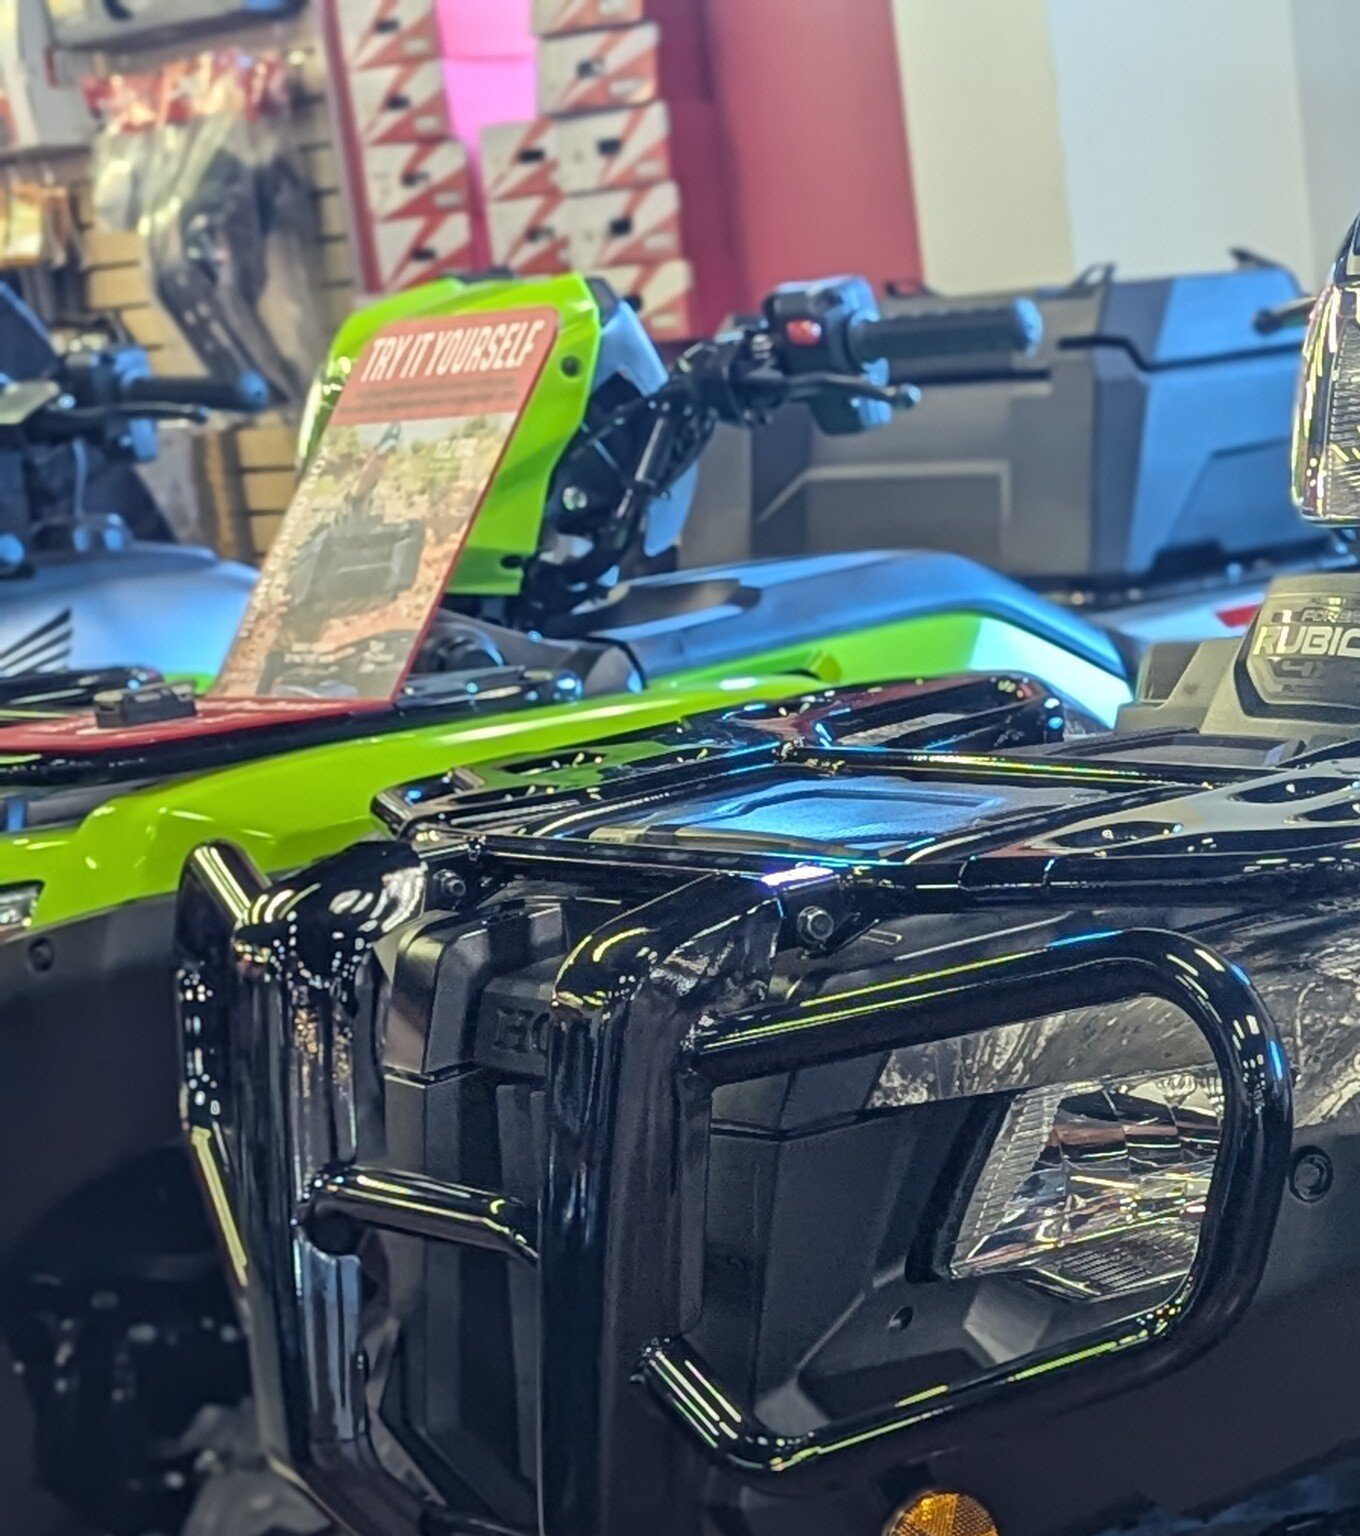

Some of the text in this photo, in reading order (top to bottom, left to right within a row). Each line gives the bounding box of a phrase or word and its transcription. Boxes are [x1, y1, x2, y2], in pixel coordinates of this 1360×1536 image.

[361, 319, 546, 383] TRY IT YOURSELF
